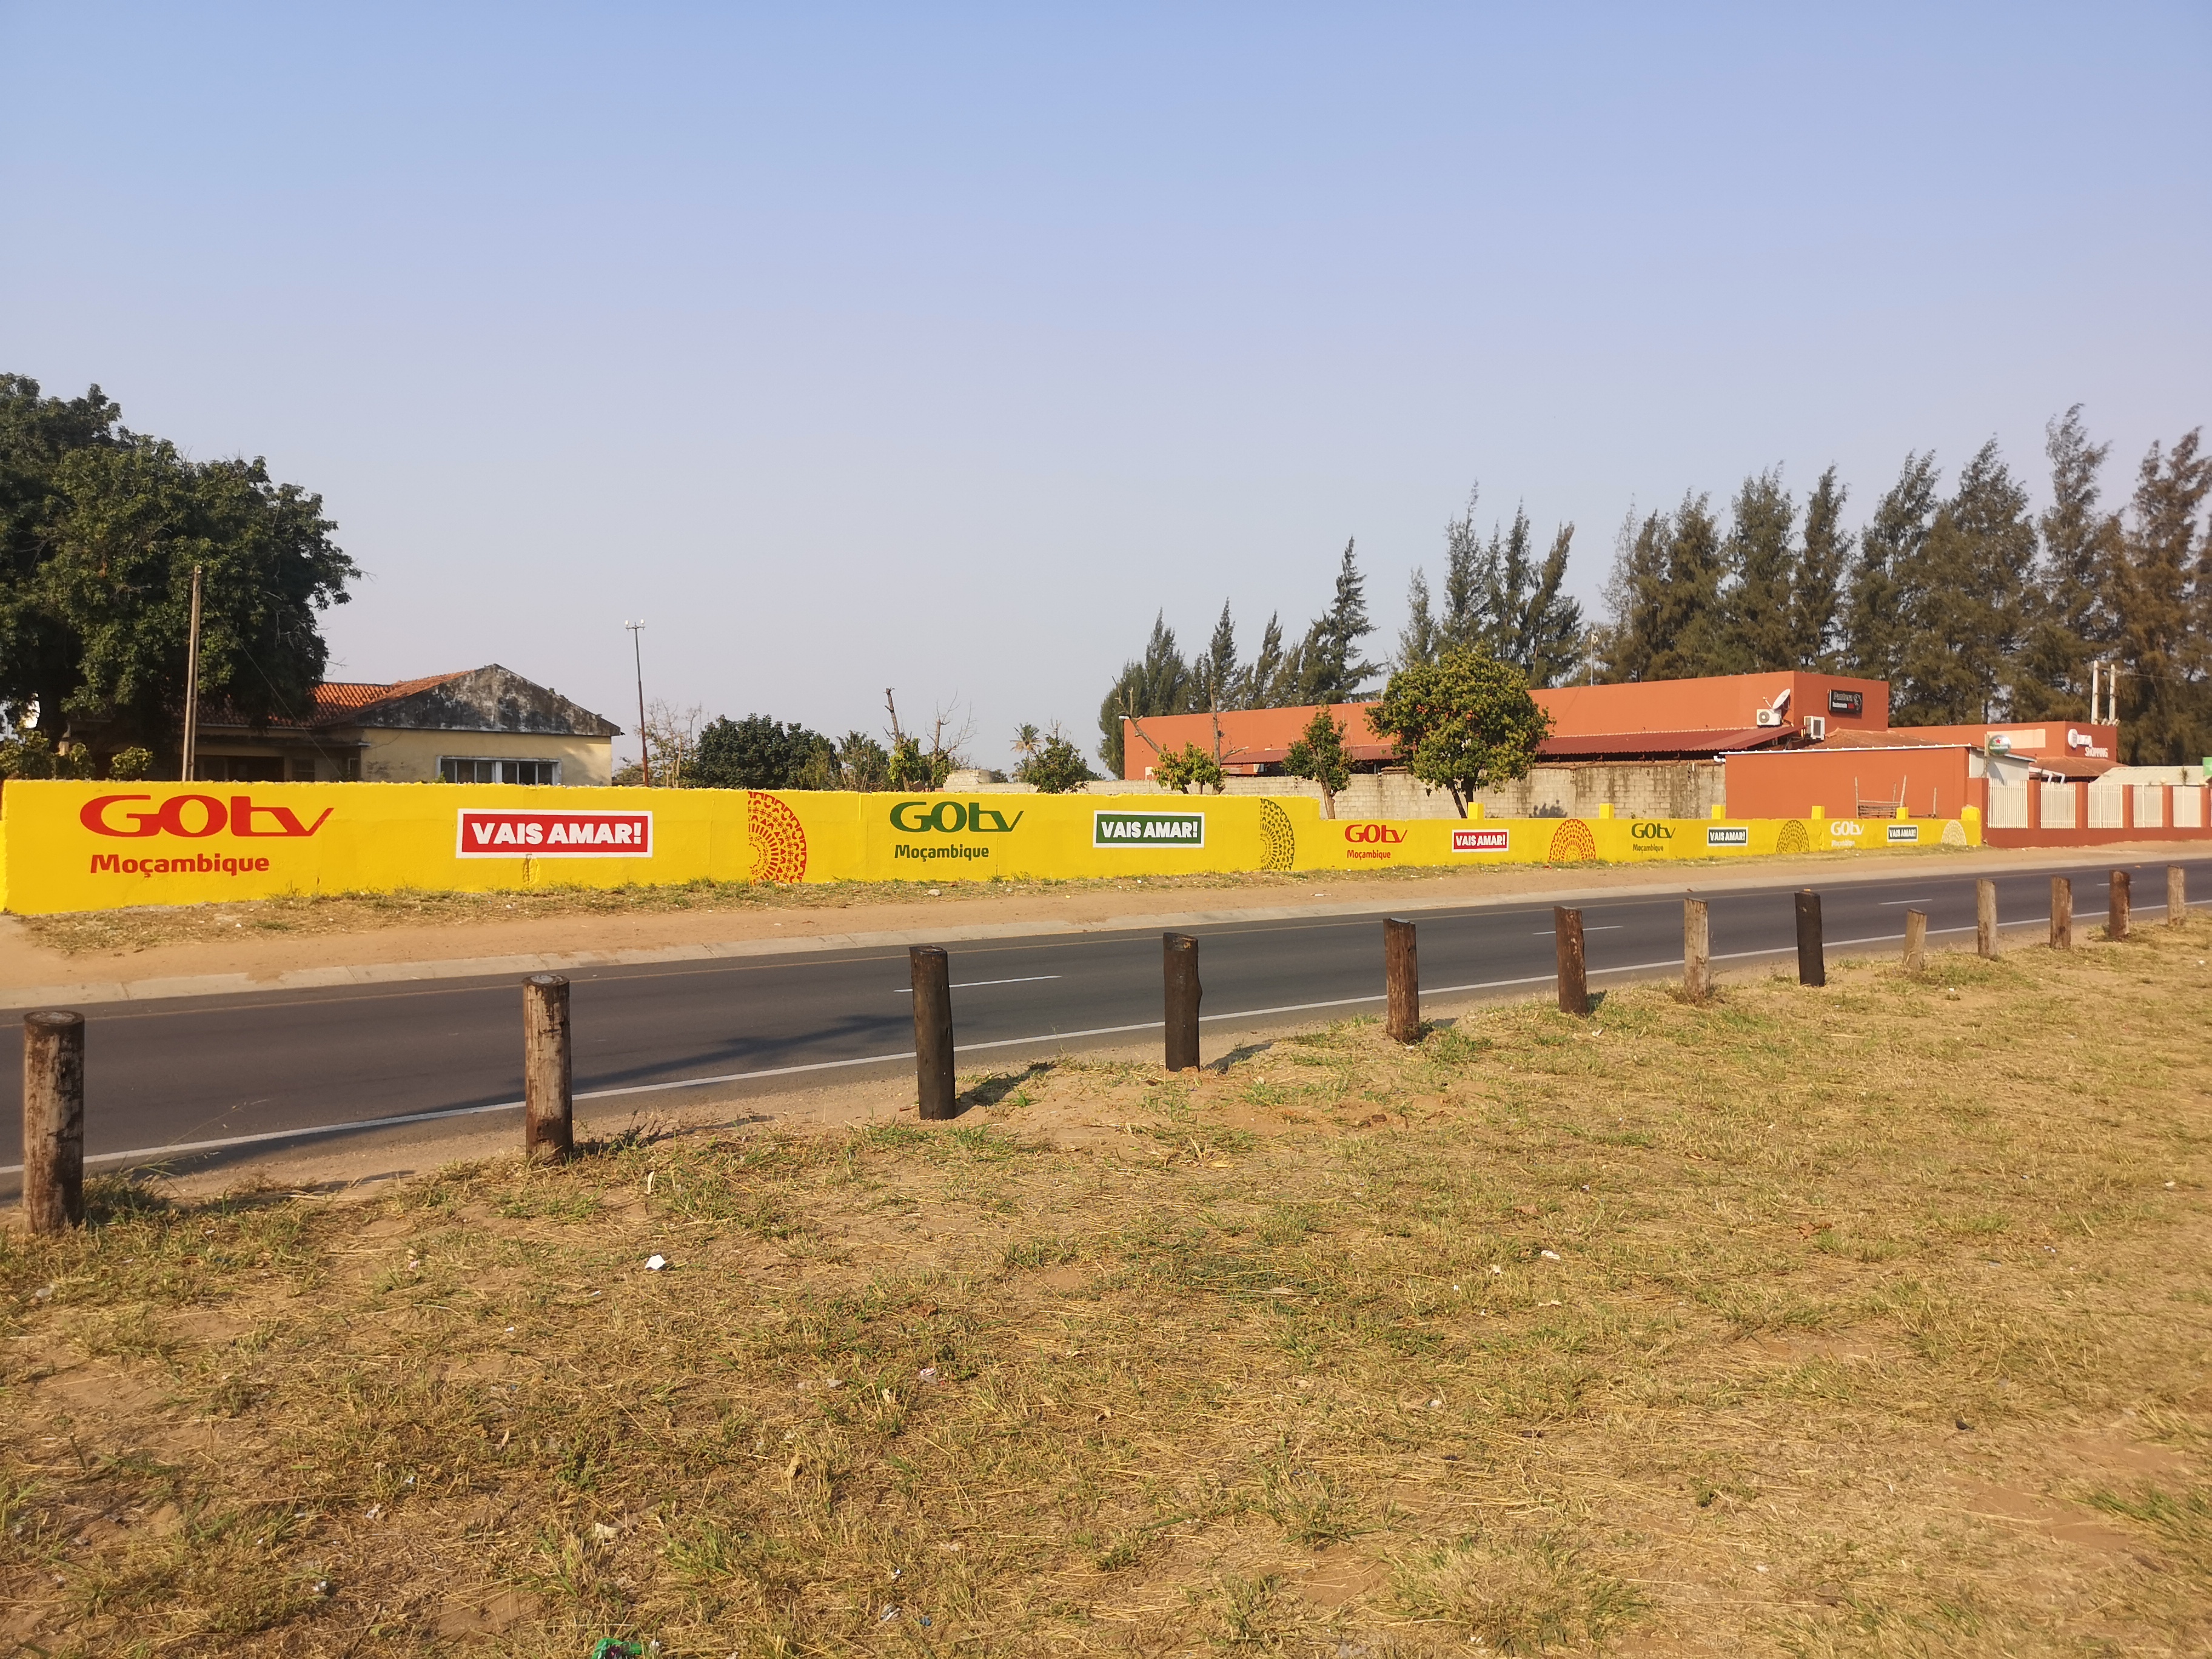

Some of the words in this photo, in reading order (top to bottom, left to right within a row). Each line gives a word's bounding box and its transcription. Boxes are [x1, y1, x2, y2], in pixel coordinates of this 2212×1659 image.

[80, 794, 335, 837] GOtv
[890, 801, 1024, 833] GOtv
[471, 822, 543, 845] VAIS
[547, 822, 642, 845] AMAR!
[1101, 821, 1142, 839] VAIS
[1143, 821, 1199, 839] AMAR!
[1344, 824, 1408, 843] GOtv
[1631, 823, 1676, 839] GOtv
[1710, 831, 1725, 842] VAIS
[1725, 831, 1745, 842] AMAR!
[1831, 821, 1865, 836] GOtv
[1889, 829, 1900, 838] VAIS
[1456, 835, 1476, 847] VAIS
[1477, 834, 1506, 846] AMAR!
[894, 843, 990, 862] Moçambique
[1347, 849, 1391, 860] Moçambique
[90, 853, 270, 878] Moçambique
